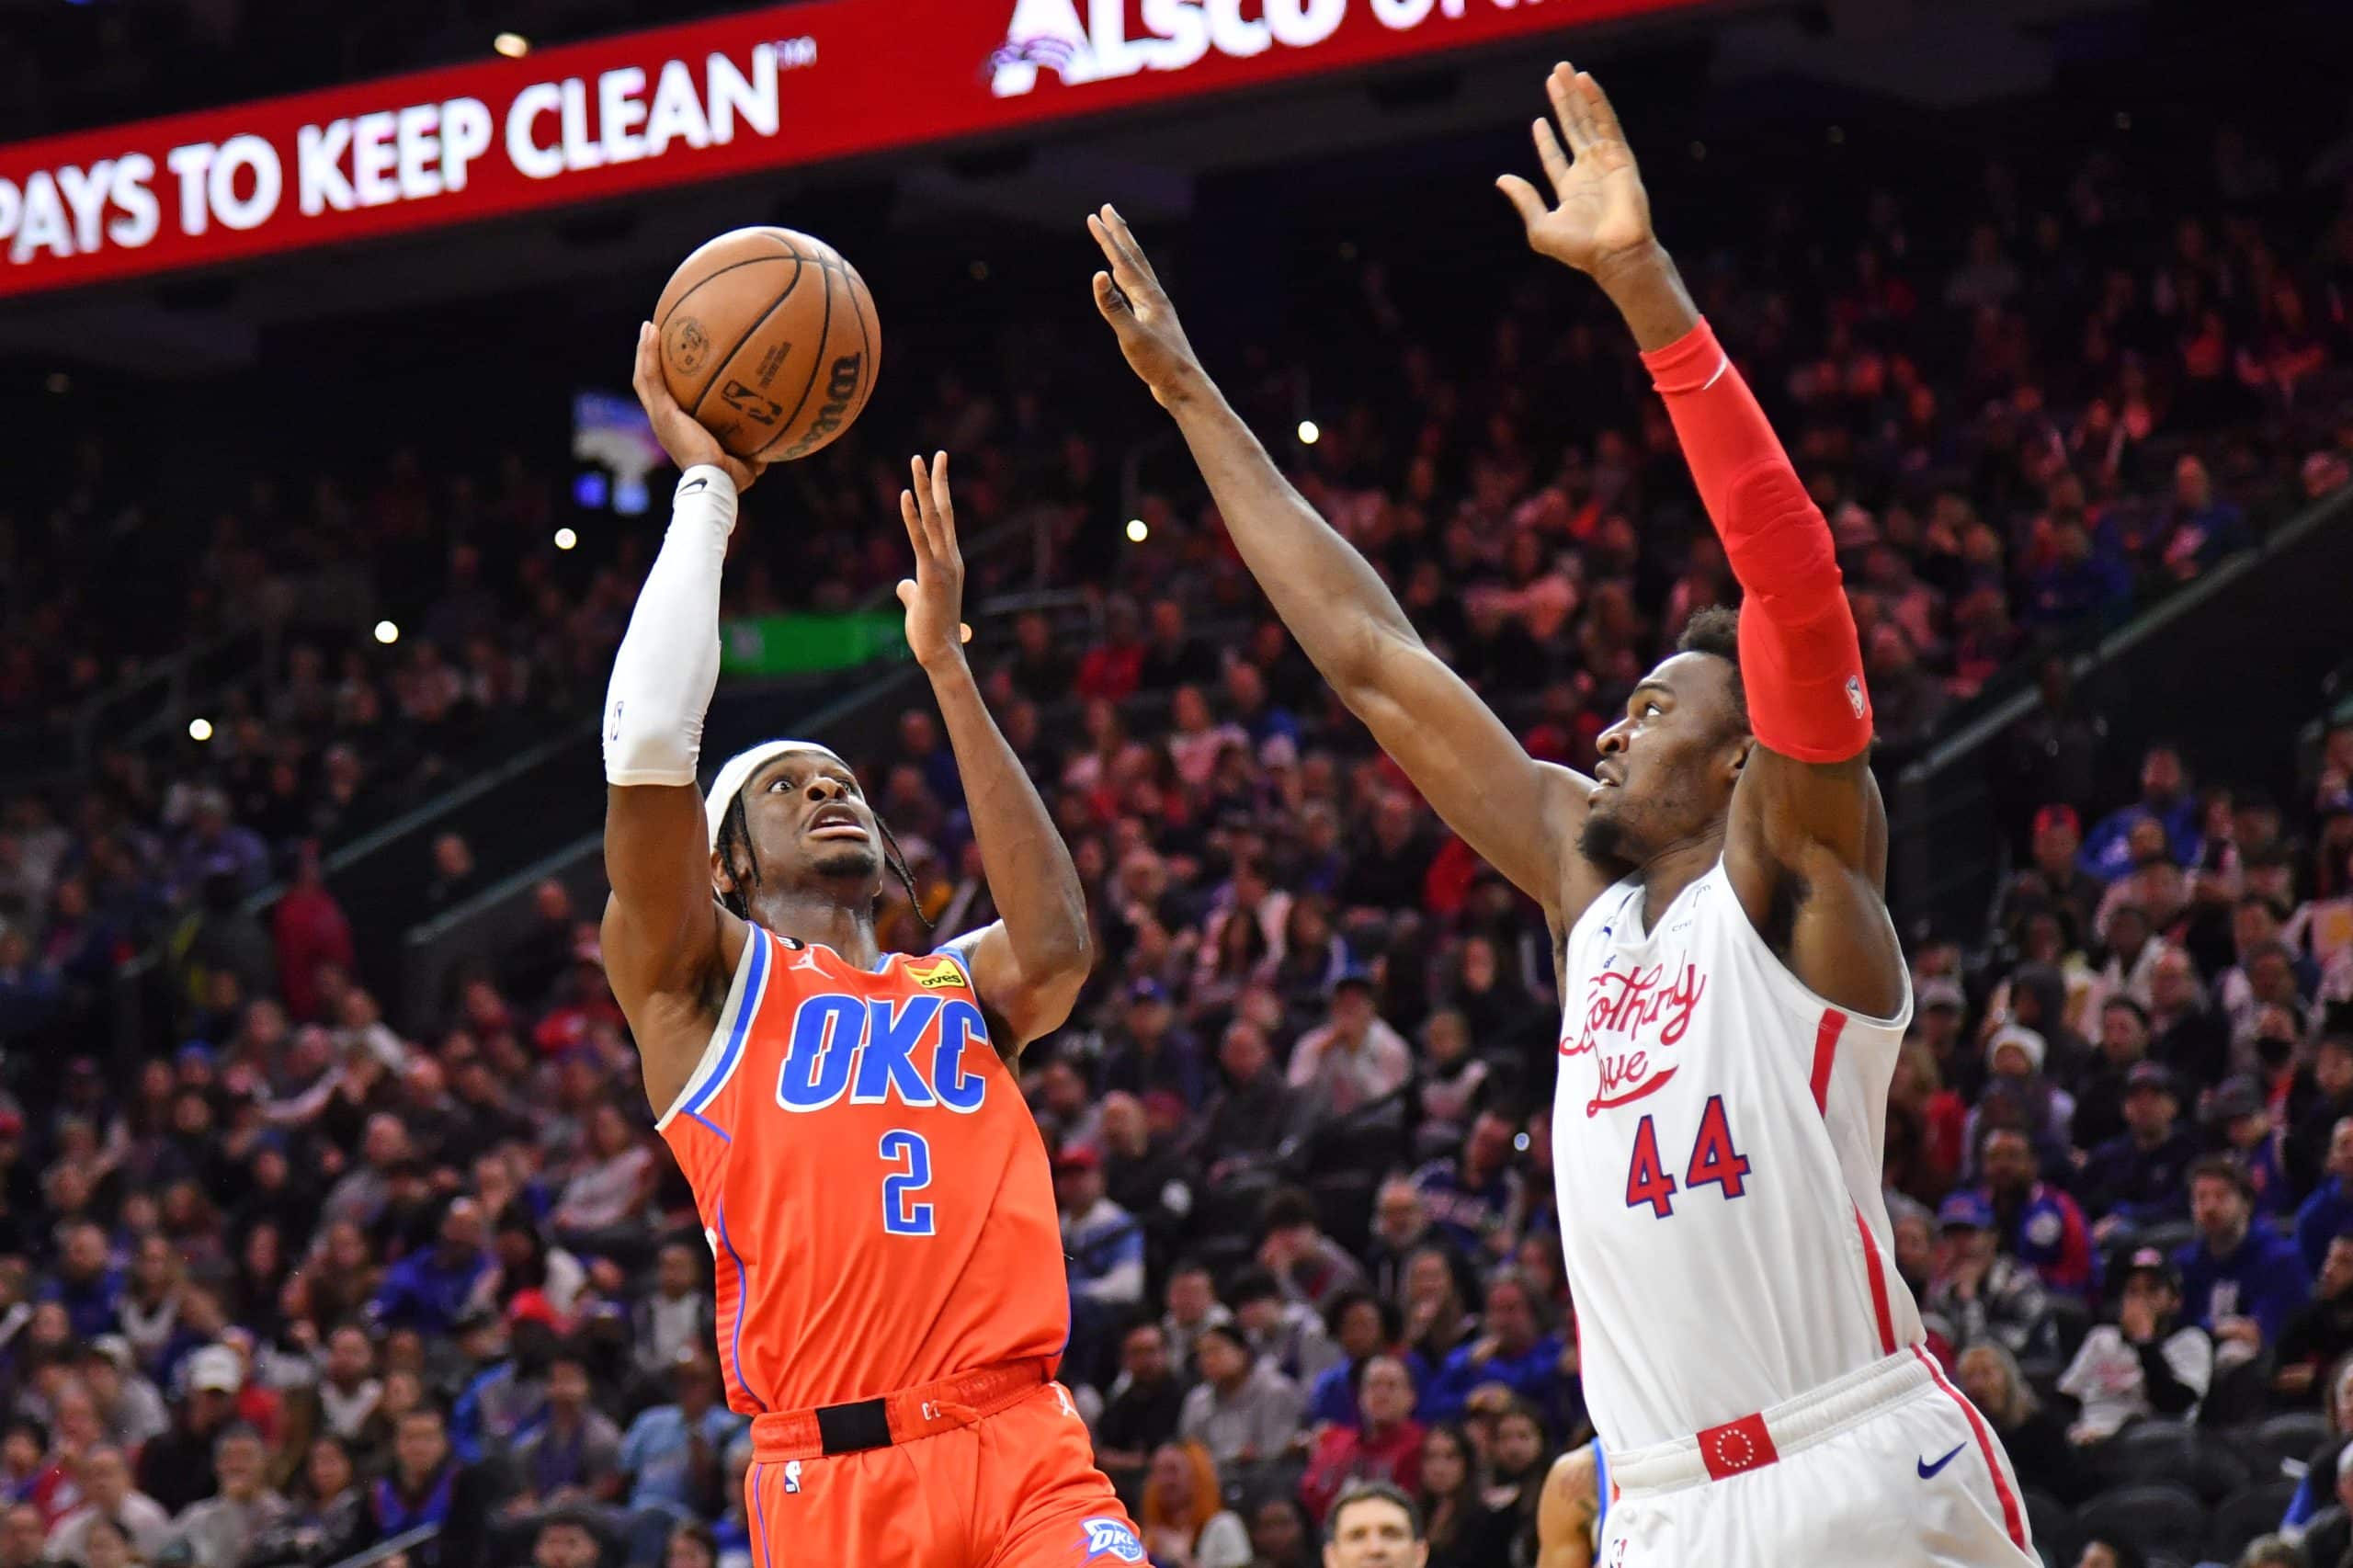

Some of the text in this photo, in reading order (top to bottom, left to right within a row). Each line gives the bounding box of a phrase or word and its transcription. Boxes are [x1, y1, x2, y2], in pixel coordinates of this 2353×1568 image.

[166, 132, 283, 236] TO
[297, 96, 494, 218] KEEP
[505, 42, 780, 180] CLEAN
[776, 993, 989, 1114] OKC
[879, 1129, 936, 1236] 2
[1625, 1094, 1751, 1221] 44
